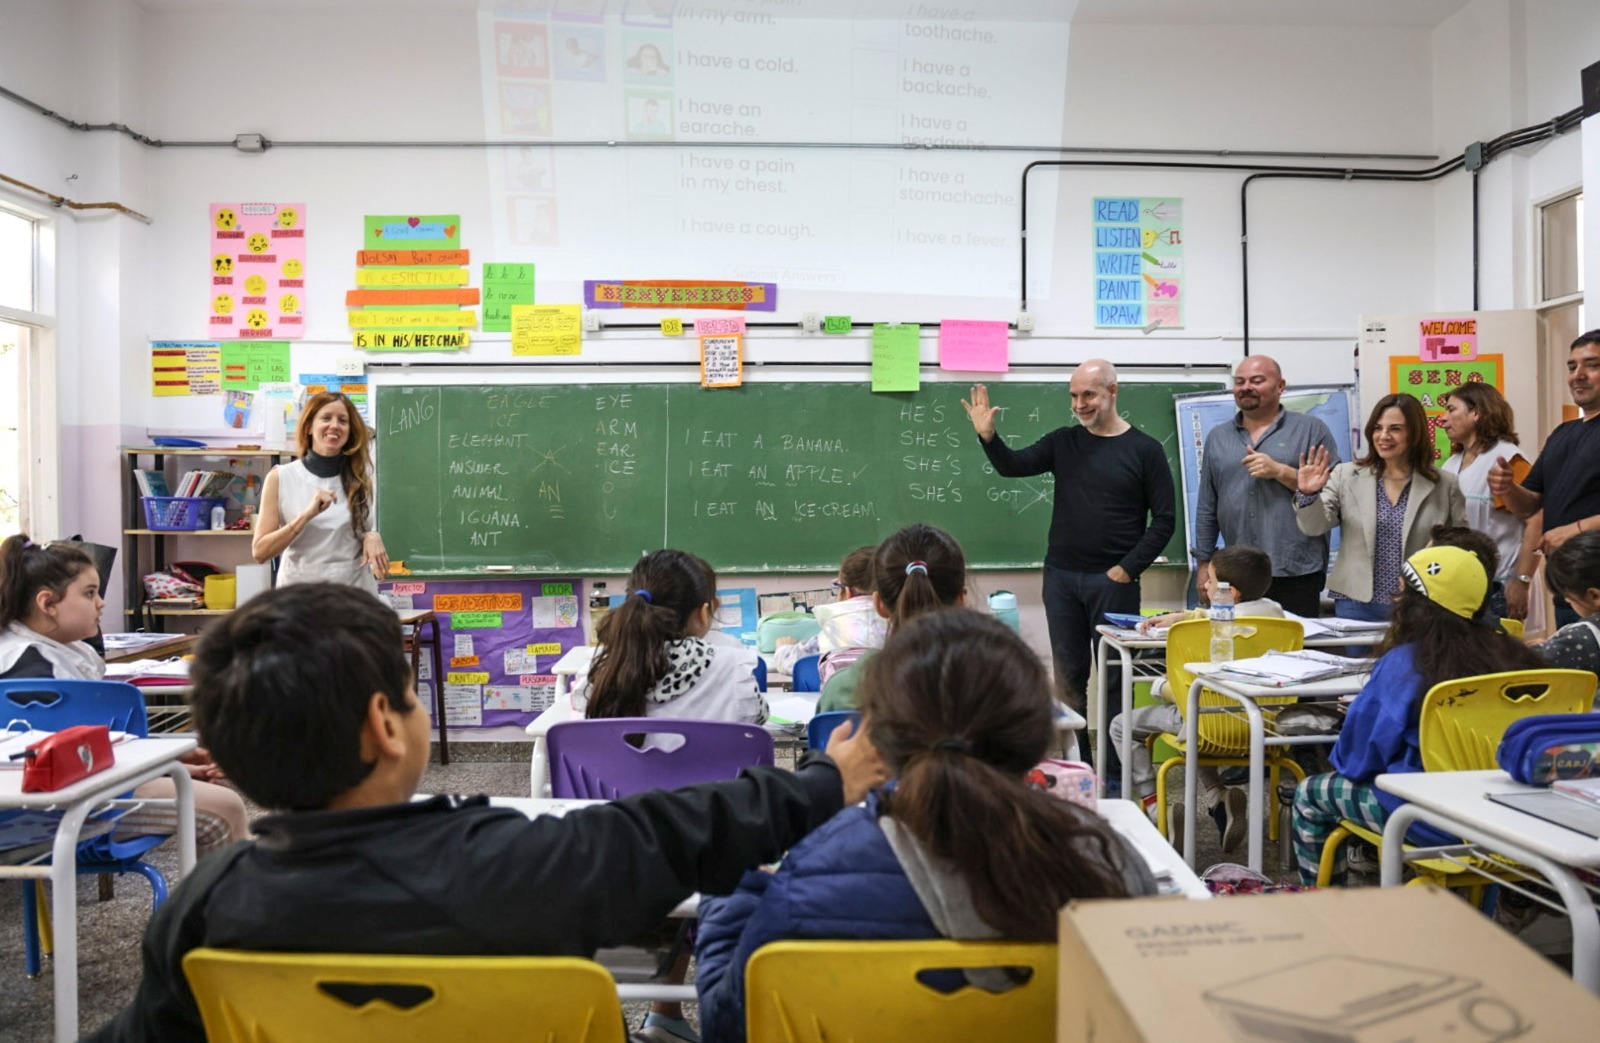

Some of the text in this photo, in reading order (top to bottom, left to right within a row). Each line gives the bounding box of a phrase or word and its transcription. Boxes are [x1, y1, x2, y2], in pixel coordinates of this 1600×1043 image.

[700, 8, 730, 25] my
[916, 5, 960, 20] have
[963, 9, 976, 21] a
[905, 22, 998, 44] toothache.
[688, 50, 734, 69] have
[738, 57, 750, 70] a
[754, 57, 800, 74] cold.
[912, 58, 954, 77] have
[959, 64, 971, 77] a
[902, 78, 991, 99] backache.
[688, 97, 734, 116] have
[737, 103, 762, 117] an
[680, 120, 761, 138] earache.
[910, 113, 953, 132] have
[956, 120, 968, 132] a
[690, 152, 734, 171] have
[738, 158, 751, 172] a
[756, 157, 795, 176] pain
[680, 173, 789, 195] in my chest.
[908, 167, 950, 184] have
[954, 173, 965, 185] a
[899, 188, 1019, 208] stomachache.
[1098, 201, 1139, 222] READ
[691, 217, 736, 235] have
[740, 223, 753, 236] a
[756, 221, 817, 241] cough.
[906, 229, 947, 245] have
[950, 233, 962, 245] a
[1096, 228, 1142, 248] LISTEN
[1099, 253, 1141, 276] WRITE
[603, 287, 754, 303] BIENVENIDOS
[1098, 280, 1140, 300] PAINT
[1100, 305, 1141, 325] DRAW
[663, 320, 680, 333] DE
[827, 318, 851, 333] LA
[1420, 320, 1477, 336] WELCOME
[487, 394, 559, 409] EAGLE
[596, 393, 634, 411] EYE
[900, 399, 946, 424] HE'S
[389, 395, 434, 435] LANG
[490, 413, 522, 429] ICE
[596, 418, 638, 440] ARM
[900, 426, 961, 448] SHE'S
[448, 432, 530, 450] ELEPHANT
[596, 442, 636, 458] EAR
[685, 428, 850, 453] I EAT A BANANA.
[449, 459, 510, 476] ANSWER
[689, 459, 852, 486] I EAT AN APPLE.
[902, 453, 961, 476] SHE'S
[539, 480, 561, 503] AN
[909, 479, 963, 503] SHE'S
[987, 486, 1026, 502] GOT
[694, 500, 699, 517] I
[707, 501, 738, 518] EAT
[756, 499, 776, 519] AN
[470, 530, 503, 547] ANT
[543, 584, 572, 596] COLOR
[436, 596, 458, 611] LOS
[1557, 760, 1588, 769] CABJ
